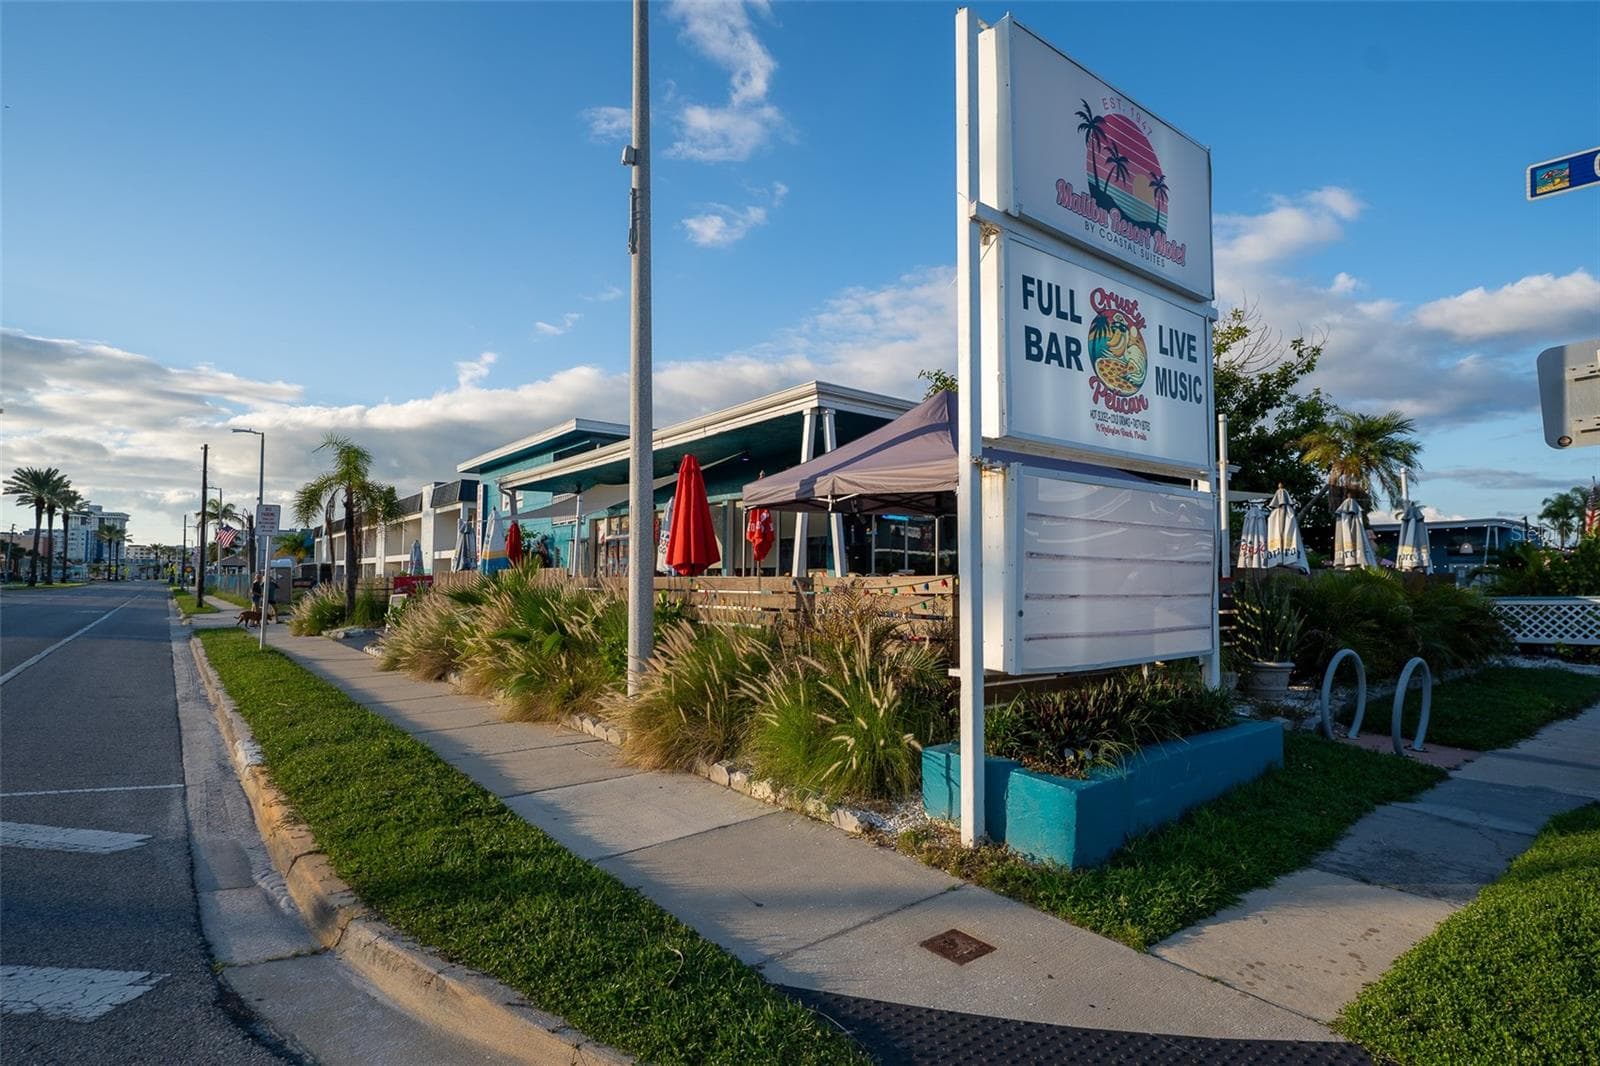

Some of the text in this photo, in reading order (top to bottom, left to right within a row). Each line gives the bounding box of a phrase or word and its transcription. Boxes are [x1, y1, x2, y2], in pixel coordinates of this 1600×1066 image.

[1102, 97, 1126, 112] EST.
[1055, 178, 1186, 267] Malibu Resort Motel
[1084, 220, 1166, 268] BY COASTAL SUITES
[1022, 274, 1082, 324] FULL
[1090, 287, 1147, 330] Crusty
[1024, 325, 1084, 372] BAR
[1158, 324, 1197, 364] LIVE
[1089, 376, 1149, 414] Pelican
[1155, 366, 1203, 404] MUSIC
